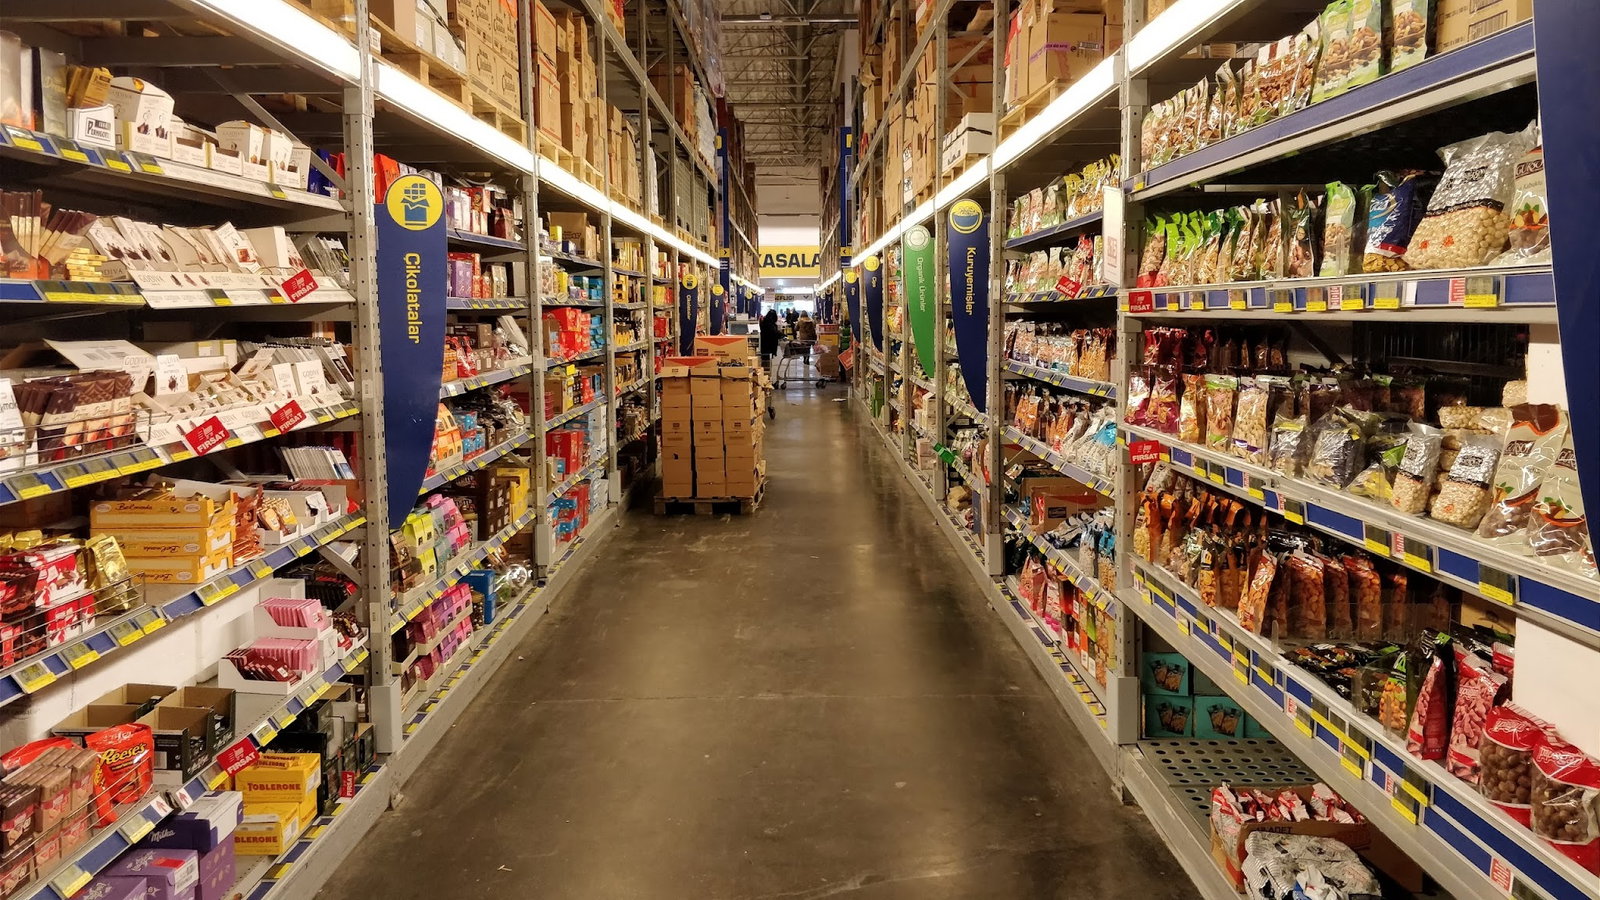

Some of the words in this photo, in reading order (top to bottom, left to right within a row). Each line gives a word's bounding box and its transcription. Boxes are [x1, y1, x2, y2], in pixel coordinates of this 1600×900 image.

[916, 257, 925, 284] Organik
[964, 247, 977, 316] Kuruyemişler
[291, 282, 315, 301] FIRSAT
[403, 252, 423, 344] Çikolatalar
[918, 285, 926, 312] Ürünler
[1130, 304, 1151, 312] FIRSAT
[279, 412, 303, 431] FIRSAT
[196, 430, 226, 453] FIRSAT
[1132, 453, 1158, 462] FIRSAT
[100, 743, 147, 766] Reese's
[227, 751, 257, 774] FIRSAT
[247, 783, 301, 792] TOBLERONE
[150, 829, 176, 842] Milka
